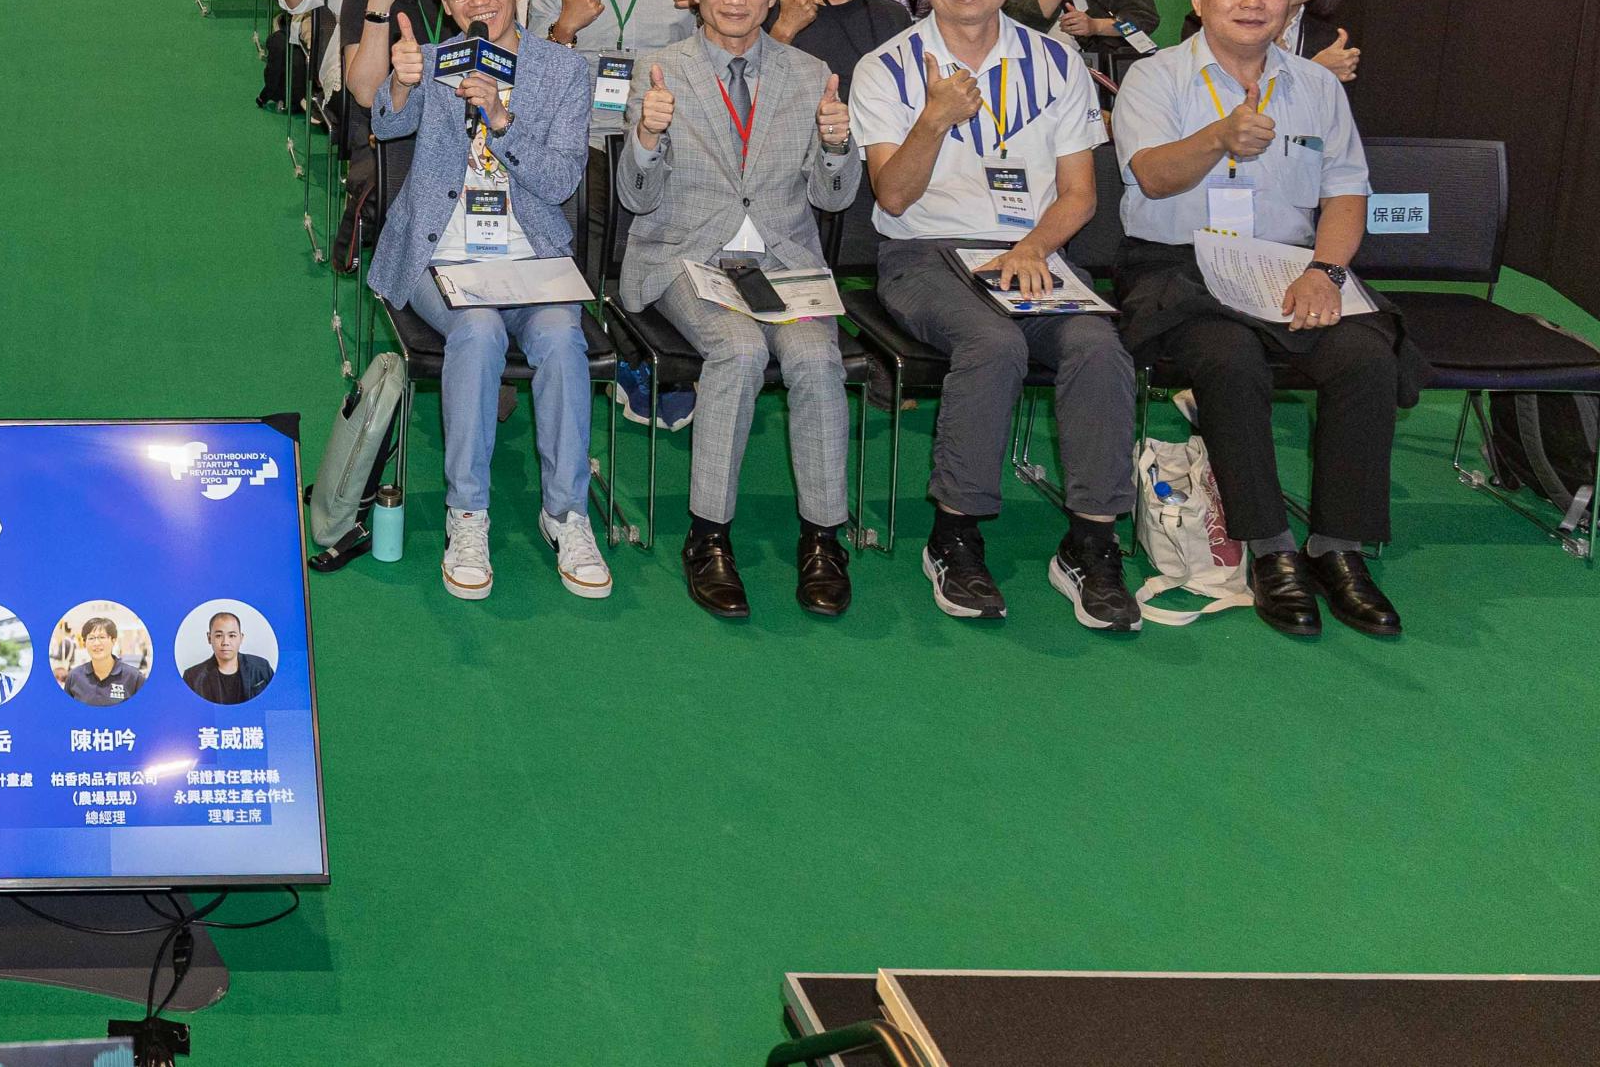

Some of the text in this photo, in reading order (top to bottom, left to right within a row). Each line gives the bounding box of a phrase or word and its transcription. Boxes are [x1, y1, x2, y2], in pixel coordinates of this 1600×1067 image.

[1373, 207, 1424, 222] 保留席
[70, 728, 136, 752] 陳柏吟
[198, 726, 264, 750] 黃威騰
[174, 789, 295, 805] 永興果菜生產合作社
[85, 810, 126, 825] 總經理
[208, 809, 262, 823] 理事主席
